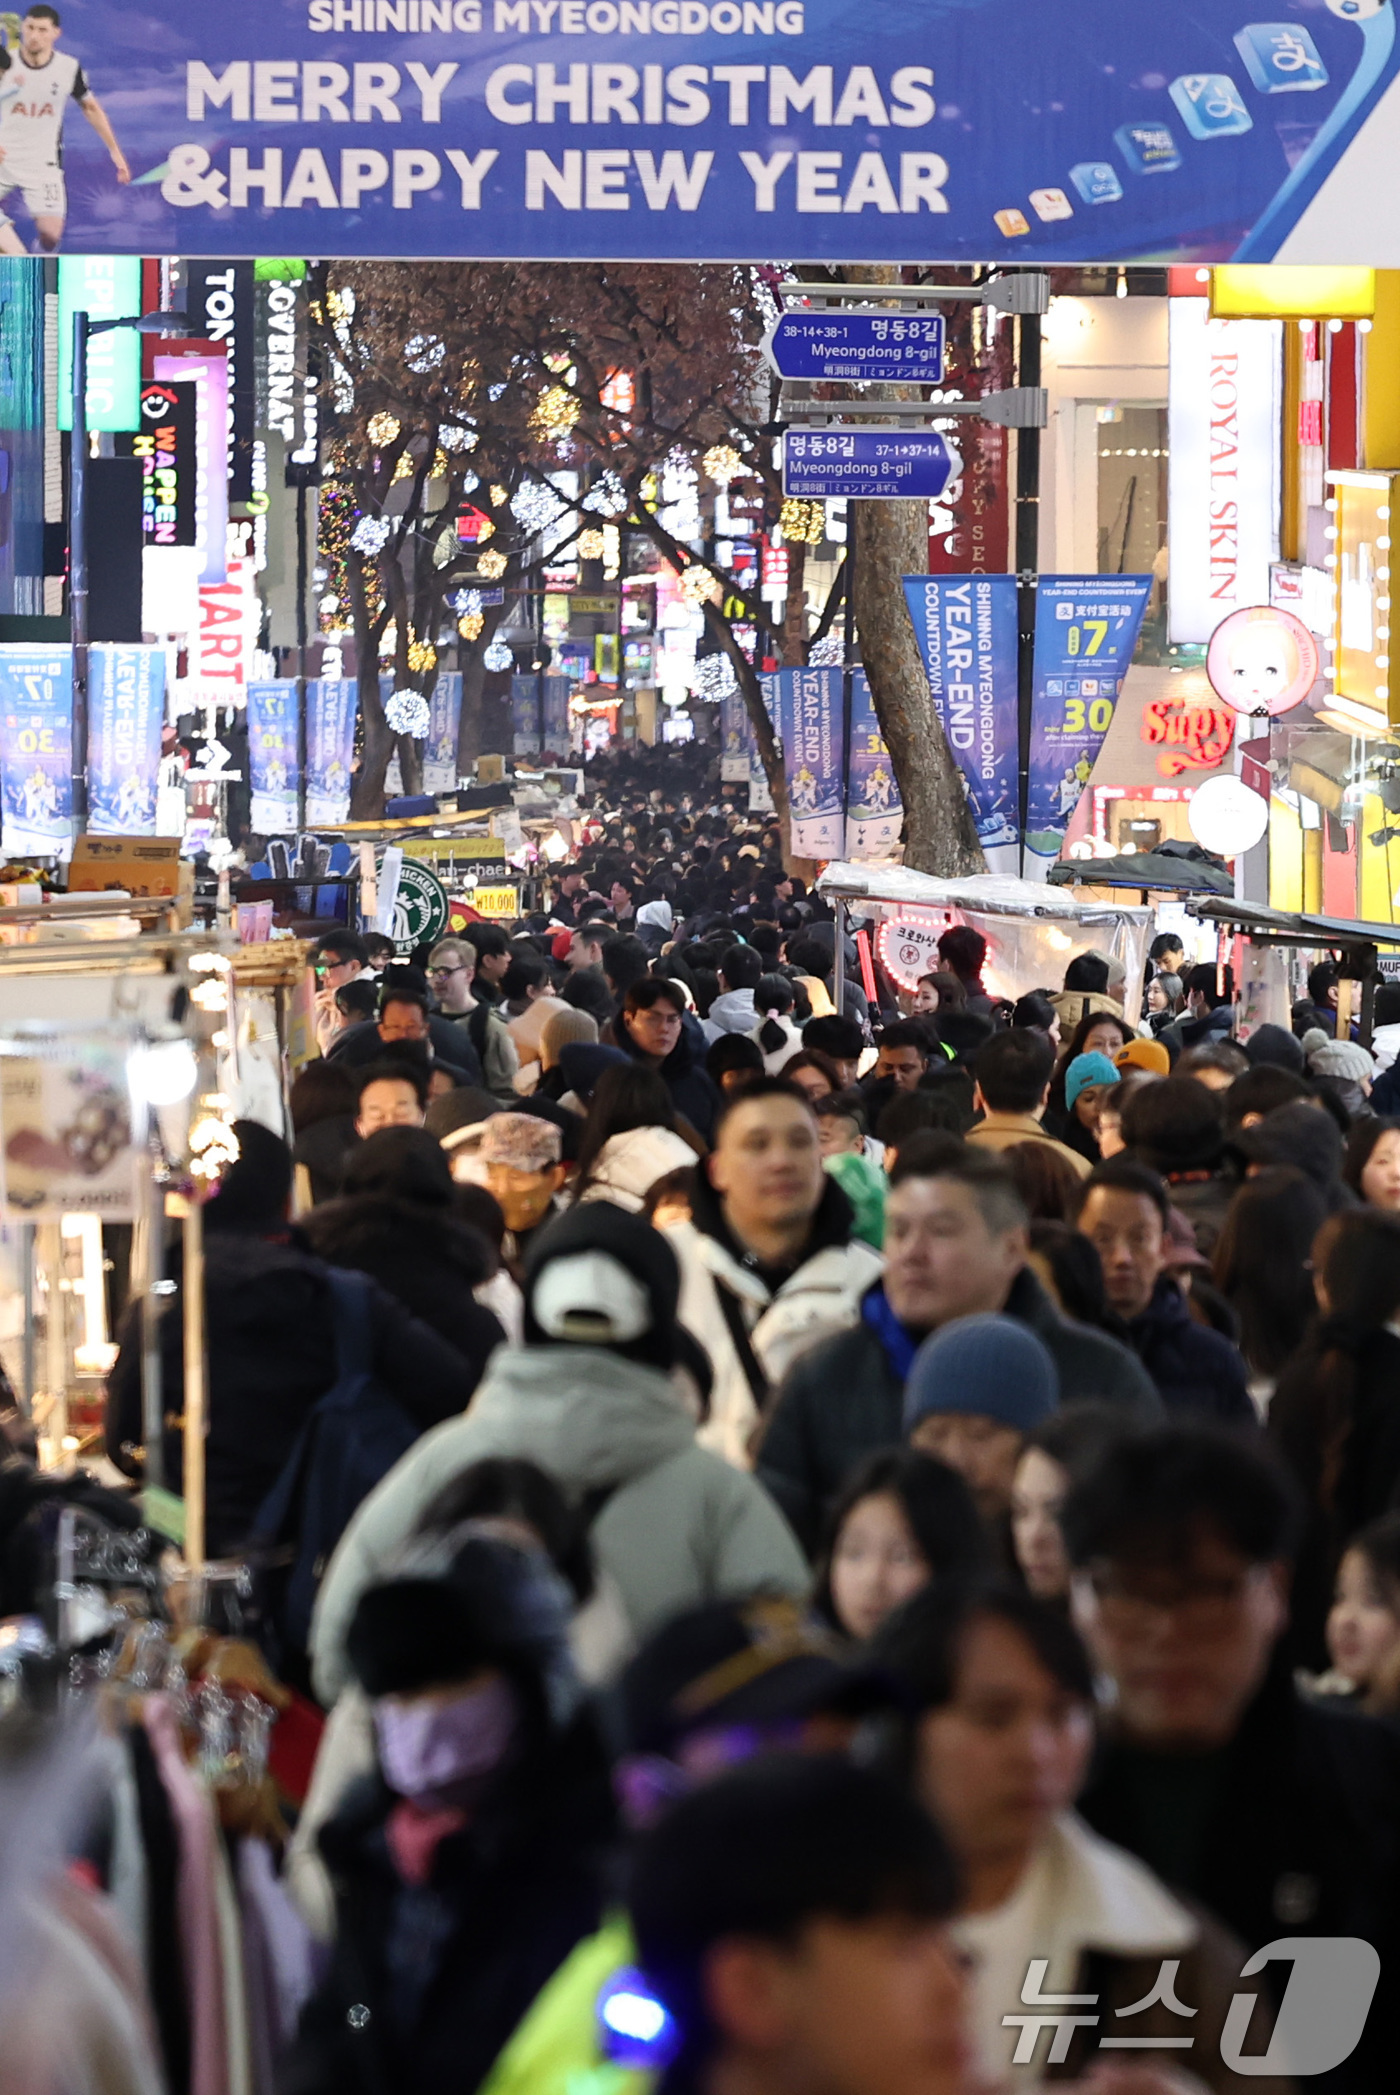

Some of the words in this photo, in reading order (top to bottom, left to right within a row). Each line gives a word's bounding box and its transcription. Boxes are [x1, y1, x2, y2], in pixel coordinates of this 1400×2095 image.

[308, 0, 481, 33] SHINING
[494, 0, 804, 35] MYEONGDONG
[11, 101, 54, 117] AIA
[186, 60, 459, 122] MERRY
[485, 62, 936, 127] CHRISTMAS
[161, 143, 499, 211] &HAPPY
[525, 149, 713, 211] NEW
[741, 152, 950, 214] YEAR
[783, 326, 815, 338] 38-14
[823, 327, 848, 338] 38-1
[811, 343, 902, 361] Myeongdong
[905, 345, 937, 361] 8-gil
[871, 319, 938, 342] 명동8길
[266, 279, 303, 442] OVERNAT
[789, 435, 854, 457] 명동8길
[1209, 352, 1239, 491] ROYAL
[790, 461, 878, 476] Myeongdong
[881, 461, 912, 477] 8-gil
[875, 444, 899, 456] 37-1
[909, 444, 940, 456] 37-14
[154, 425, 178, 543] WAPPEN
[1208, 500, 1239, 600] SKIN
[924, 582, 943, 696] COUNTDOWN
[975, 582, 992, 651] SHINING
[820, 670, 830, 708] SHINING
[945, 582, 975, 749] YEAR-END
[792, 670, 803, 732] COUNTDOWN
[803, 670, 820, 763] YEAR-END
[978, 656, 995, 779] MYEONGDONG
[1062, 698, 1113, 733] 30
[794, 735, 803, 763] EVENT
[1140, 698, 1236, 778] Supy
[399, 868, 437, 897] HICKEN
[897, 926, 936, 948] 크로와상
